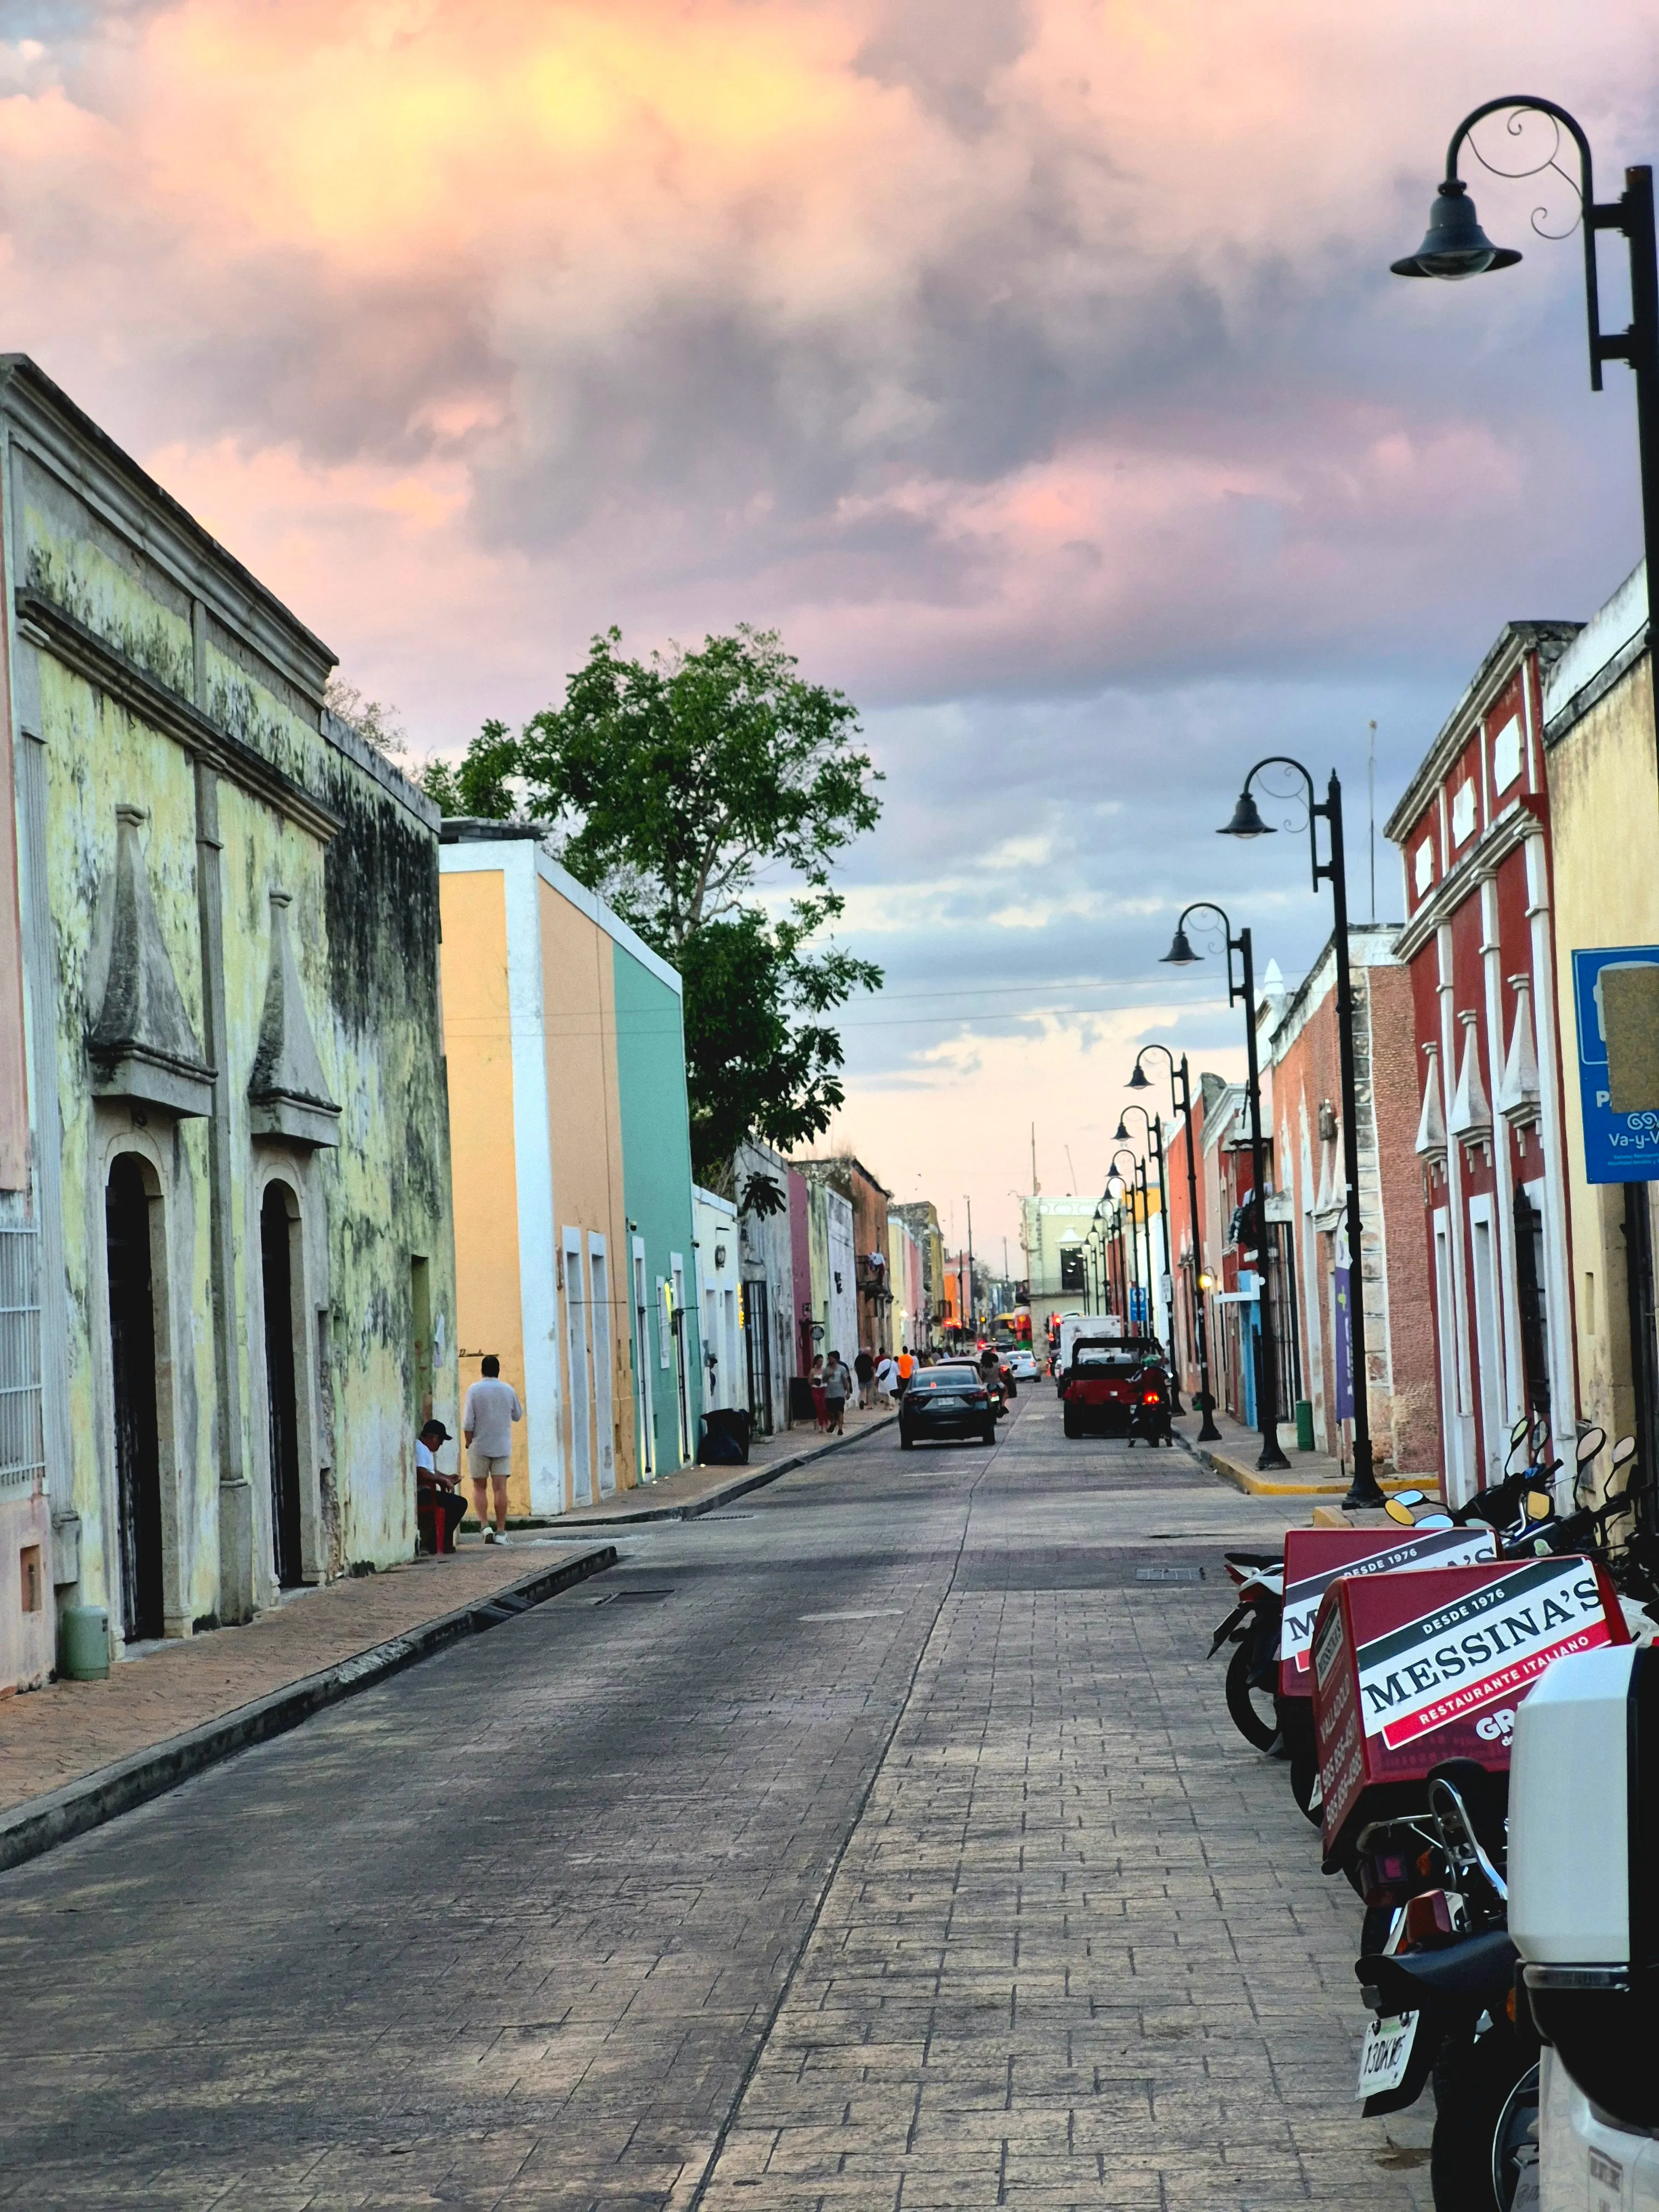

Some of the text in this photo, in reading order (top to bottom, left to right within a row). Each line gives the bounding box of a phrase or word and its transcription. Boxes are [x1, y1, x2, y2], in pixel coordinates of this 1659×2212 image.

[1387, 1548, 1417, 1564] 1976
[1422, 1588, 1505, 1635] DESDE 1976
[1362, 1577, 1603, 1714] MESSINA'S
[1418, 1636, 1589, 1725] RESTAURANTE ITALIANO
[1476, 1703, 1520, 1740] GR
